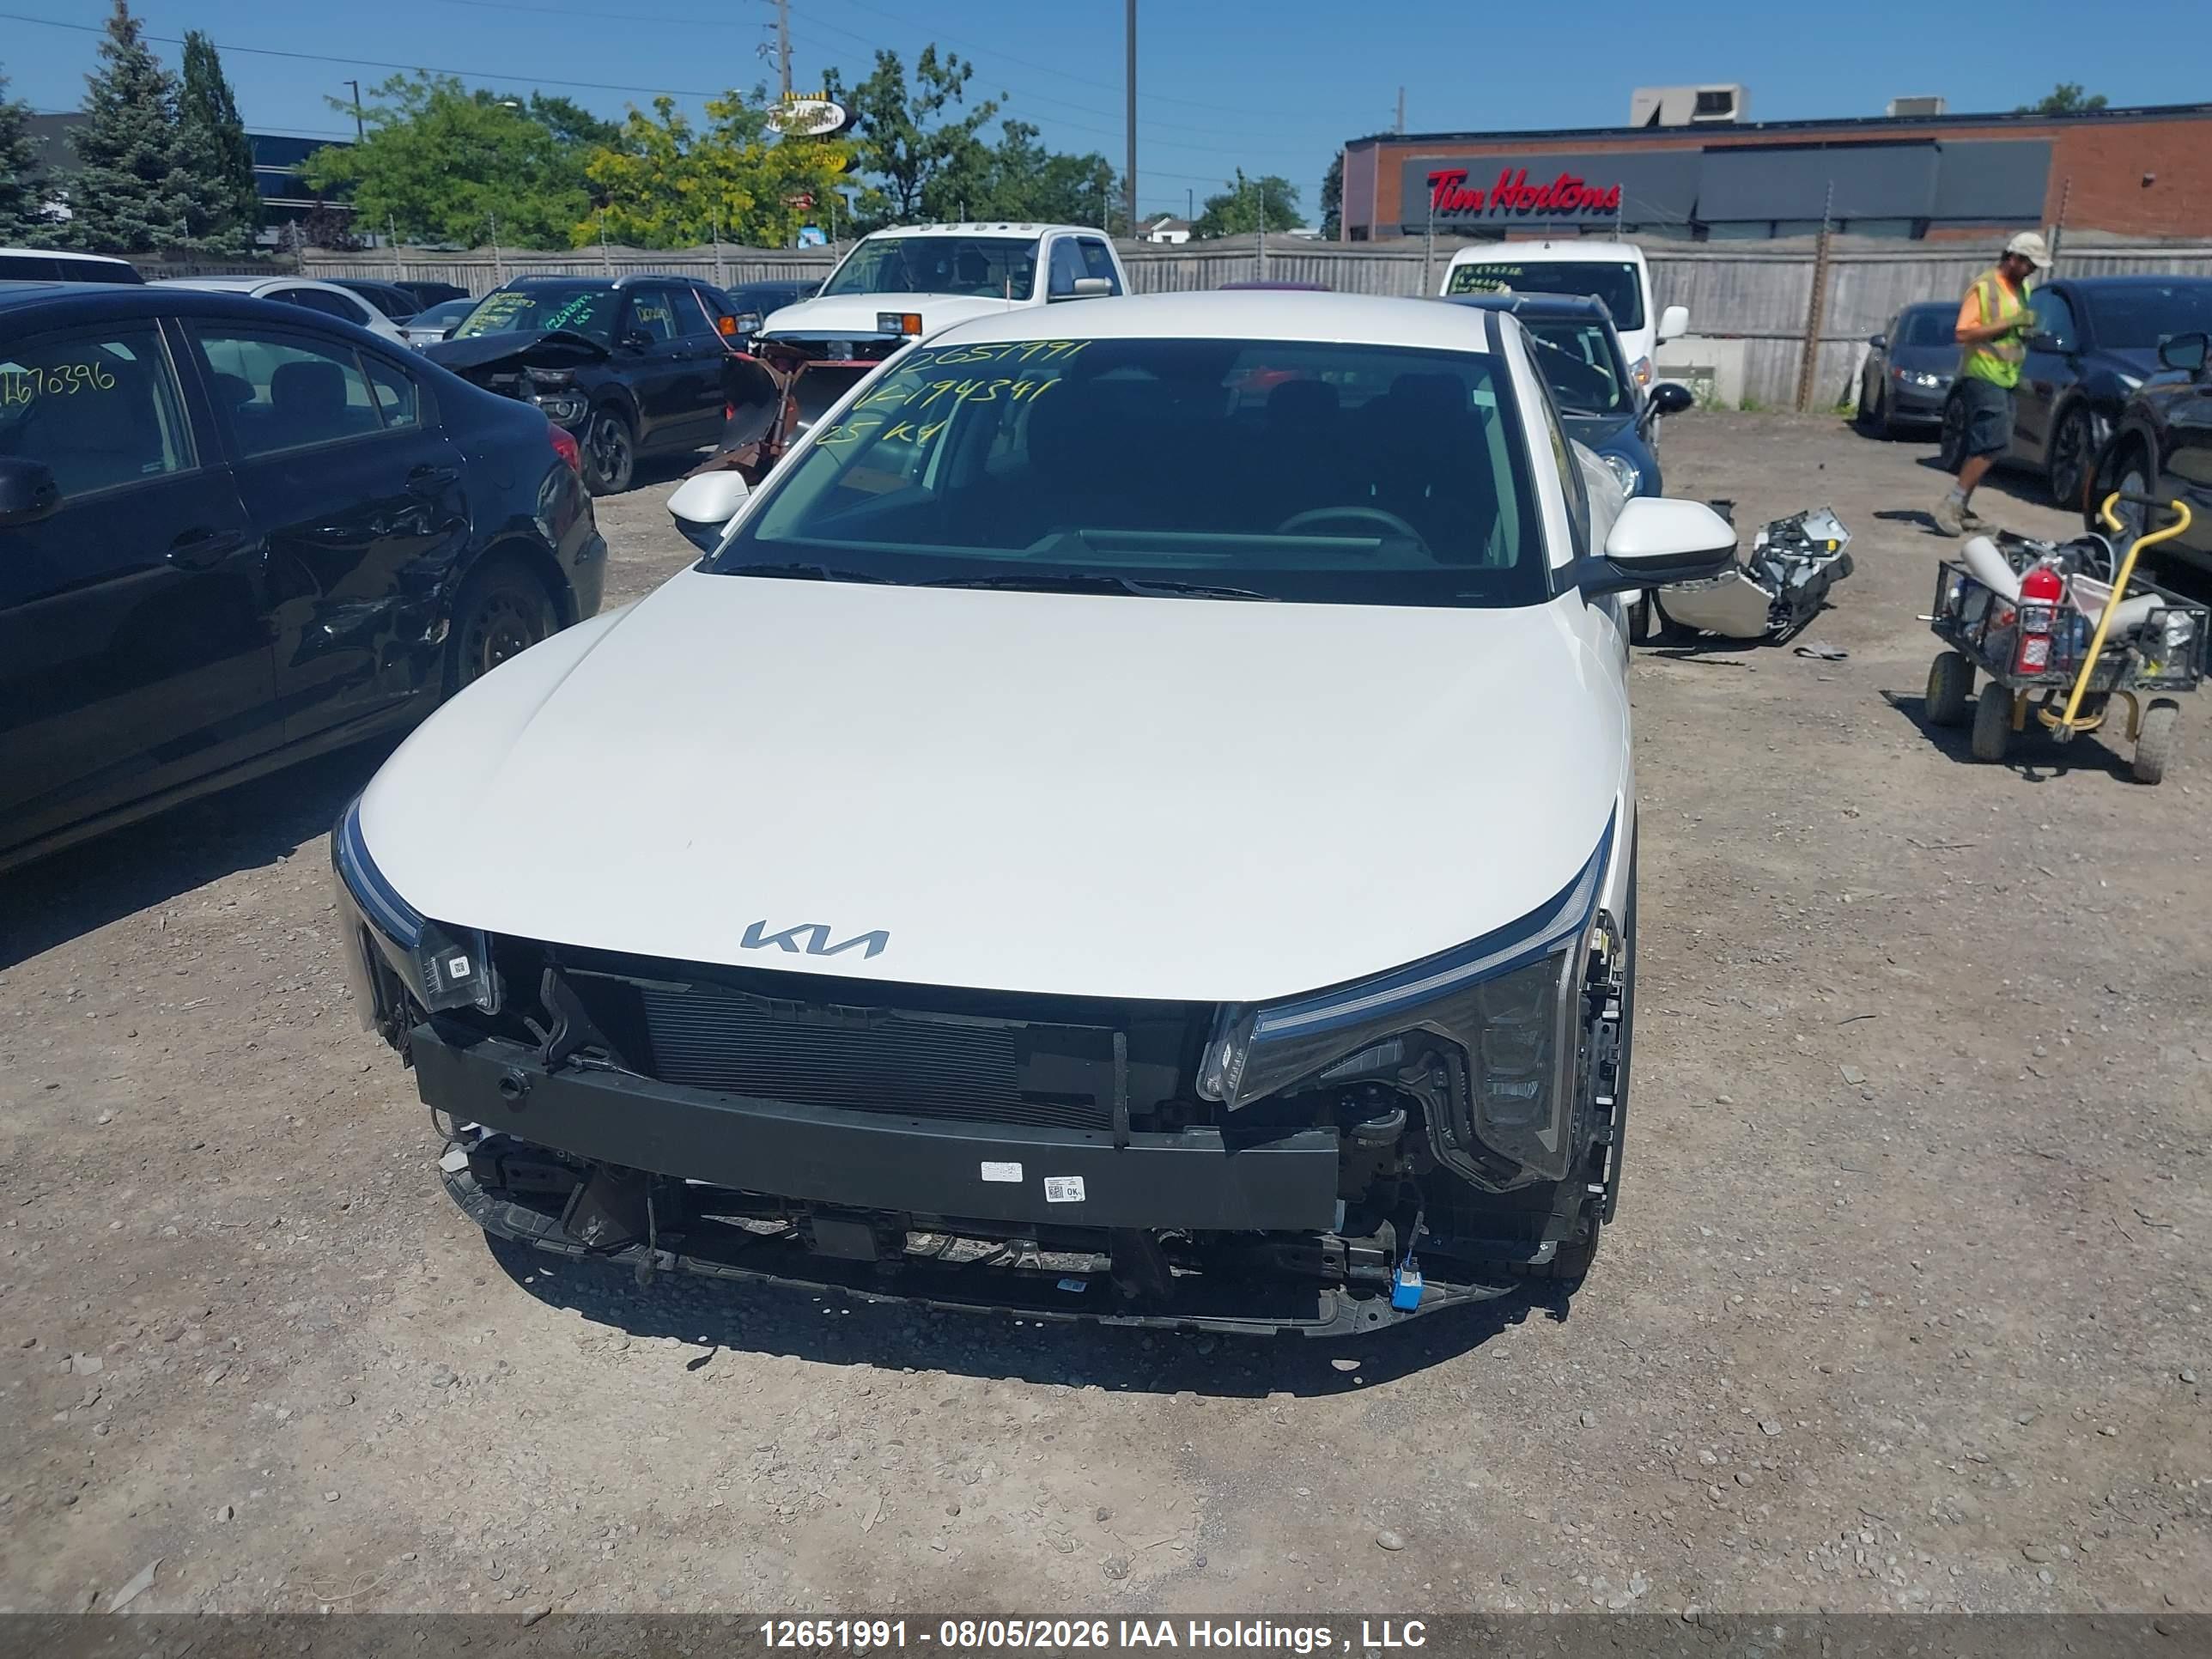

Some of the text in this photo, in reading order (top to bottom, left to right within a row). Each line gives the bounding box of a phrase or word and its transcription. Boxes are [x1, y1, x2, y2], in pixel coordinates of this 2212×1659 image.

[1427, 167, 1621, 212] Tim Hortons
[884, 340, 1092, 378] 12651991
[816, 422, 883, 445] 25
[1066, 1188, 1079, 1196] OK
